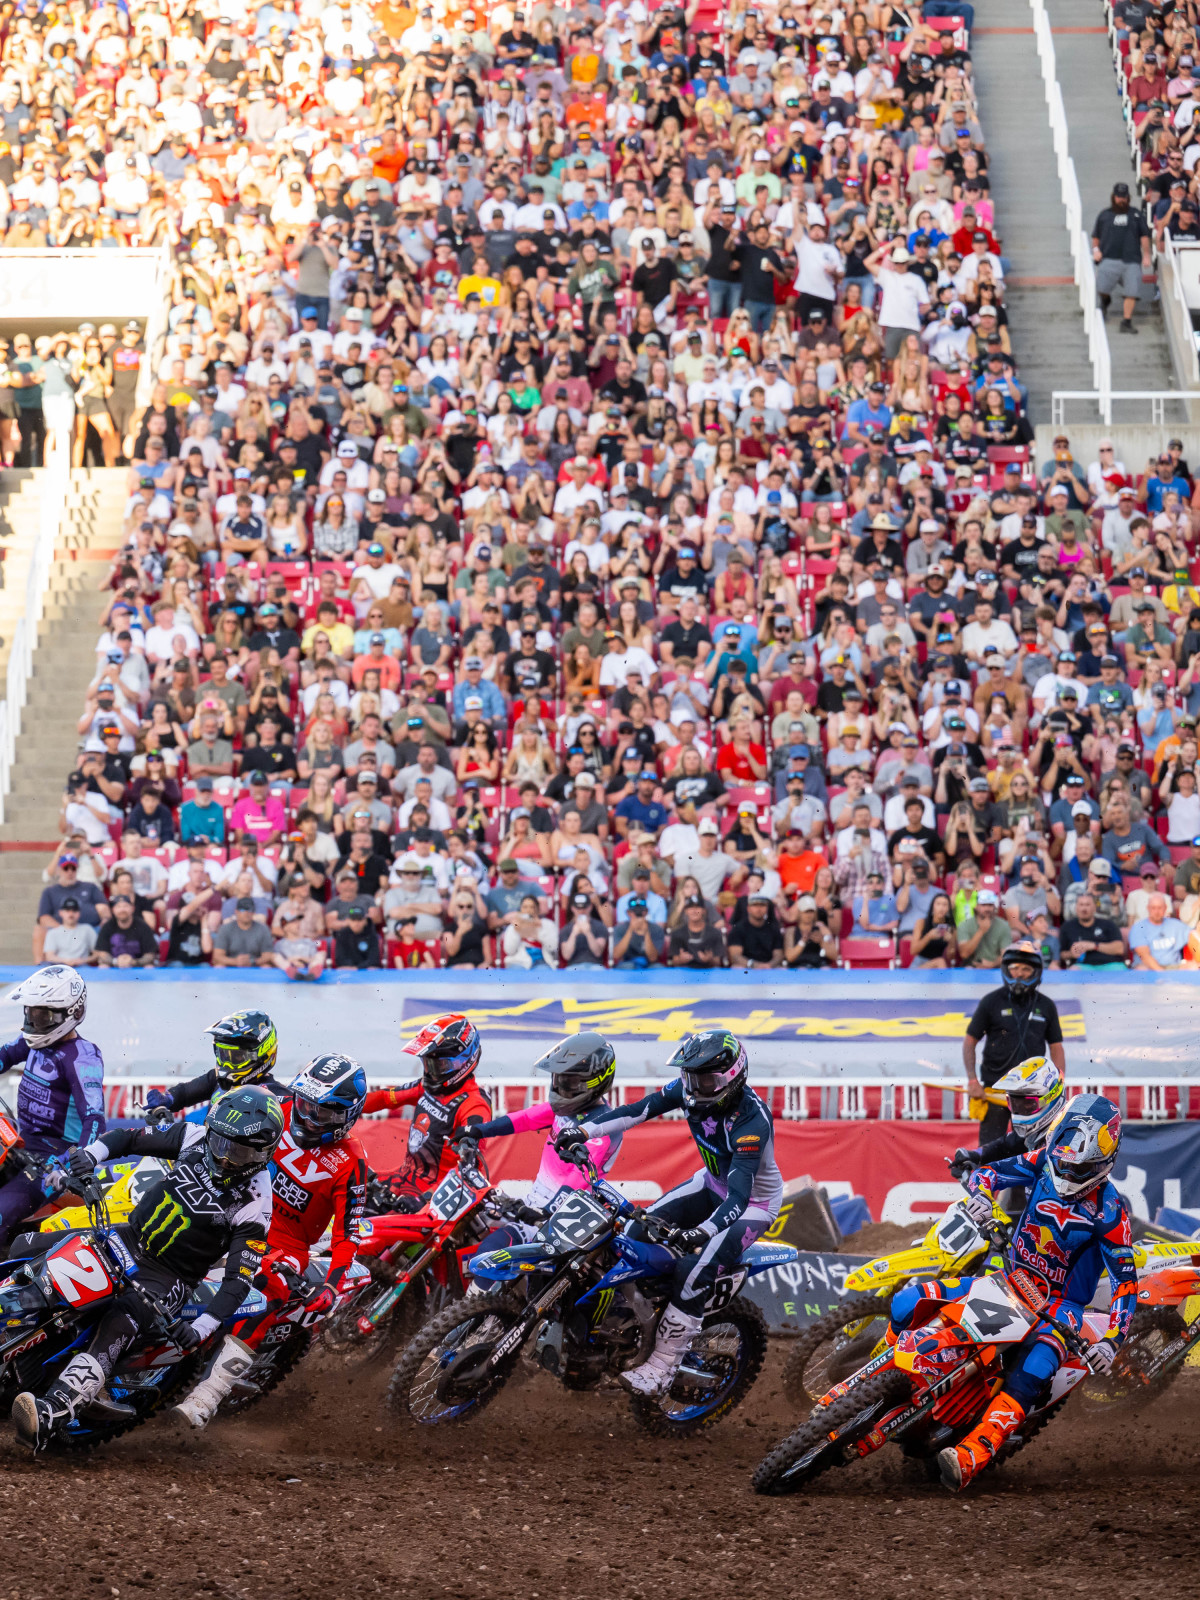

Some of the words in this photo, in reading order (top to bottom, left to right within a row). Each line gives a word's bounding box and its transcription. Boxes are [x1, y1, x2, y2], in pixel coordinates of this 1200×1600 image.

[243, 1121, 262, 1136] FLY
[166, 1164, 225, 1214] FLY
[272, 1180, 305, 1210] LOCK
[276, 1172, 308, 1201] QUAD
[272, 1200, 300, 1223] NDA
[549, 1197, 601, 1247] 28
[723, 1203, 743, 1225] FOX
[681, 1228, 703, 1241] FOX
[939, 1213, 977, 1252] 11
[249, 1253, 262, 1263] YAM
[760, 1253, 790, 1263] DUNLOP
[1016, 1235, 1039, 1269] Red
[1038, 1258, 1067, 1285] Bull
[1151, 1260, 1177, 1270] DUNLOP
[47, 1248, 109, 1302] 2
[748, 1255, 854, 1297] MONS
[1012, 1274, 1040, 1308] RENTHAL
[783, 1302, 839, 1317] EN
[967, 1298, 1022, 1336] 4
[491, 1322, 527, 1365] DUNLOP
[871, 1341, 889, 1360] DUN
[848, 1354, 889, 1388] DUNOP
[889, 1396, 929, 1429] DUNLP
